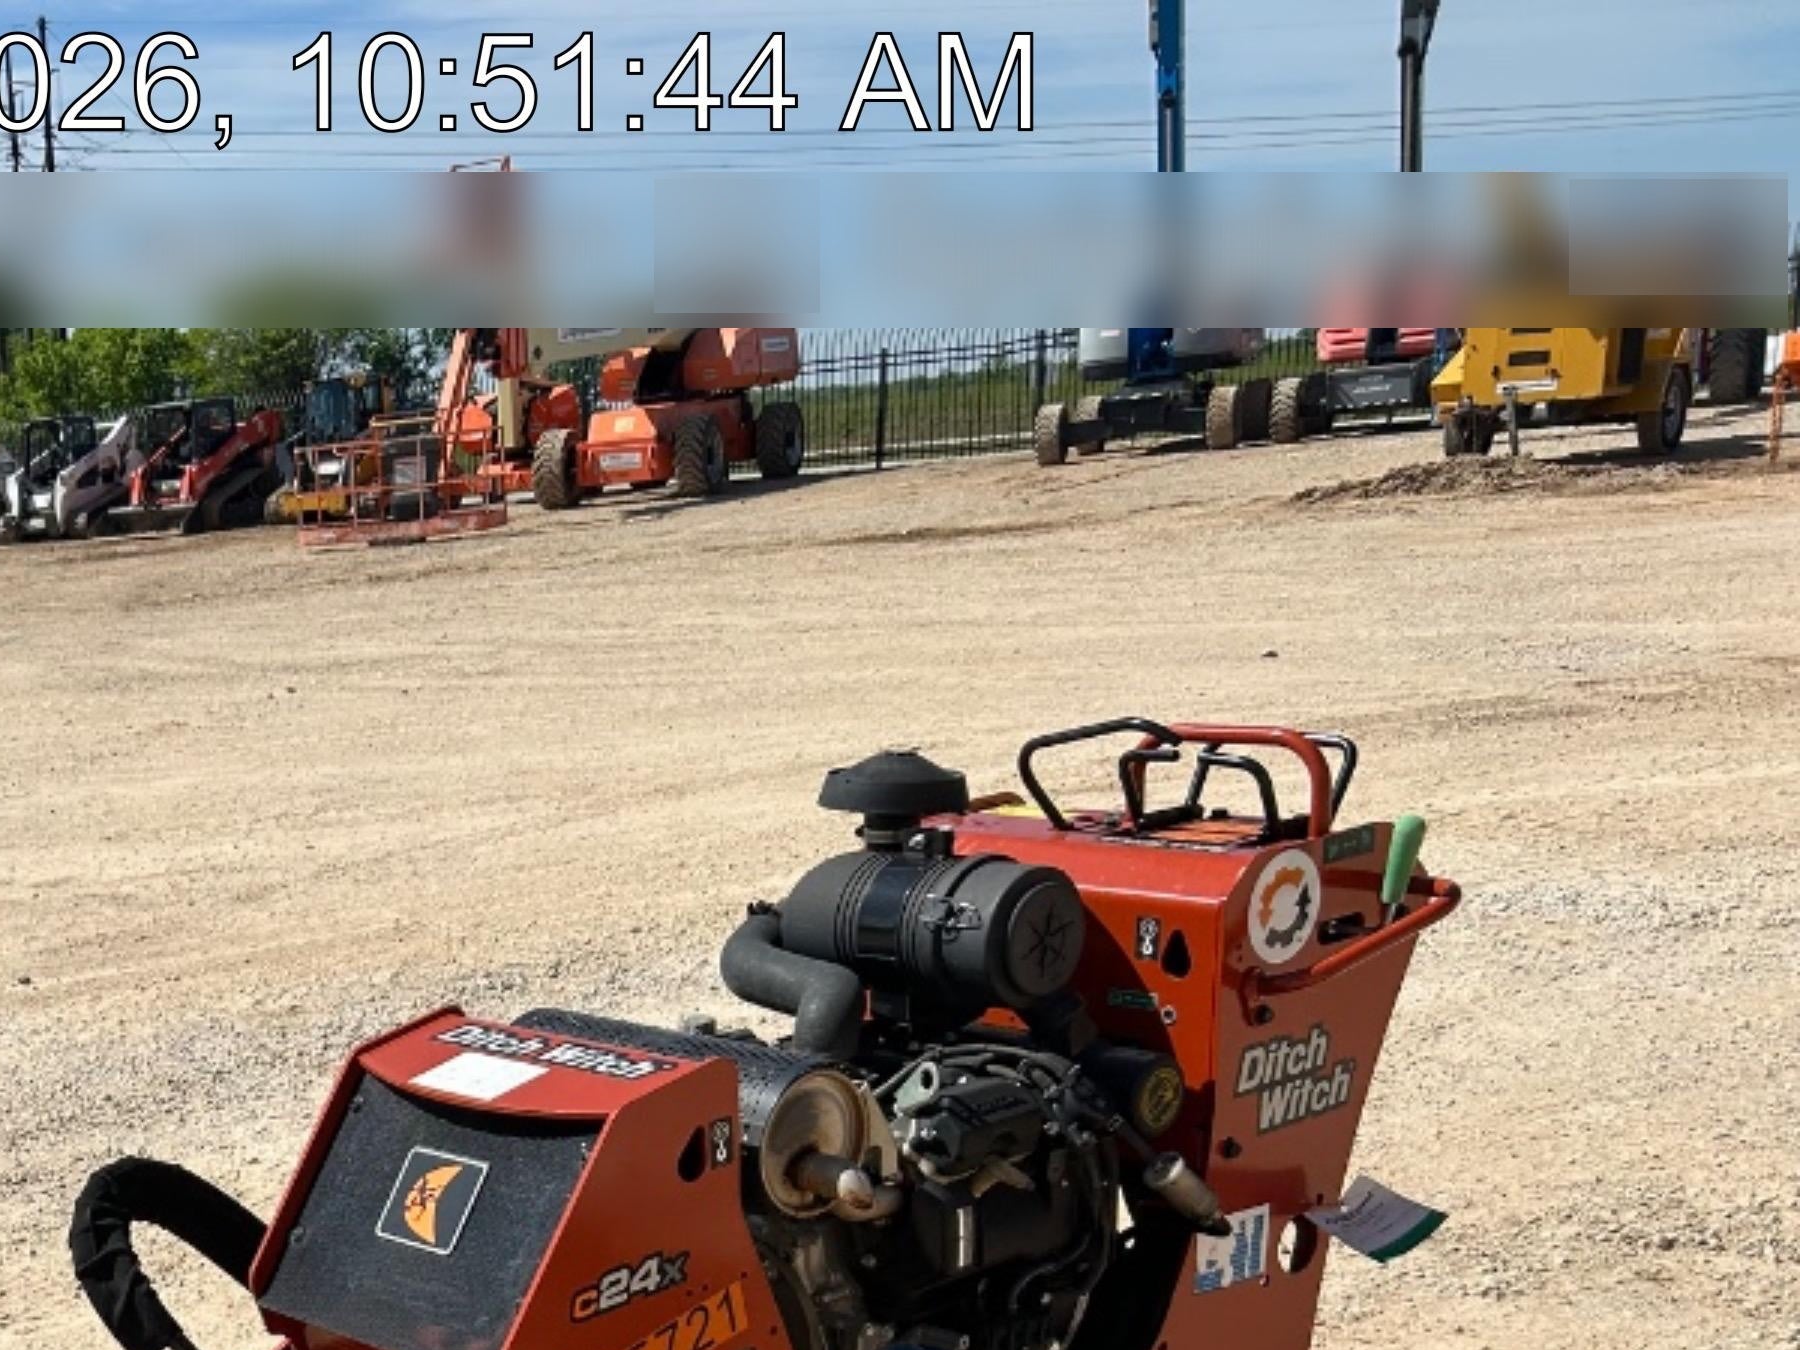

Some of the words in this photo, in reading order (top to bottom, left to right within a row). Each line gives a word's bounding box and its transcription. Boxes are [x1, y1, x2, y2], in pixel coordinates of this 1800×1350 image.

[437, 1024, 544, 1054] Ditch
[537, 1042, 656, 1079] Witch
[1236, 1027, 1328, 1094] Ditch
[1259, 1063, 1351, 1130] Witch
